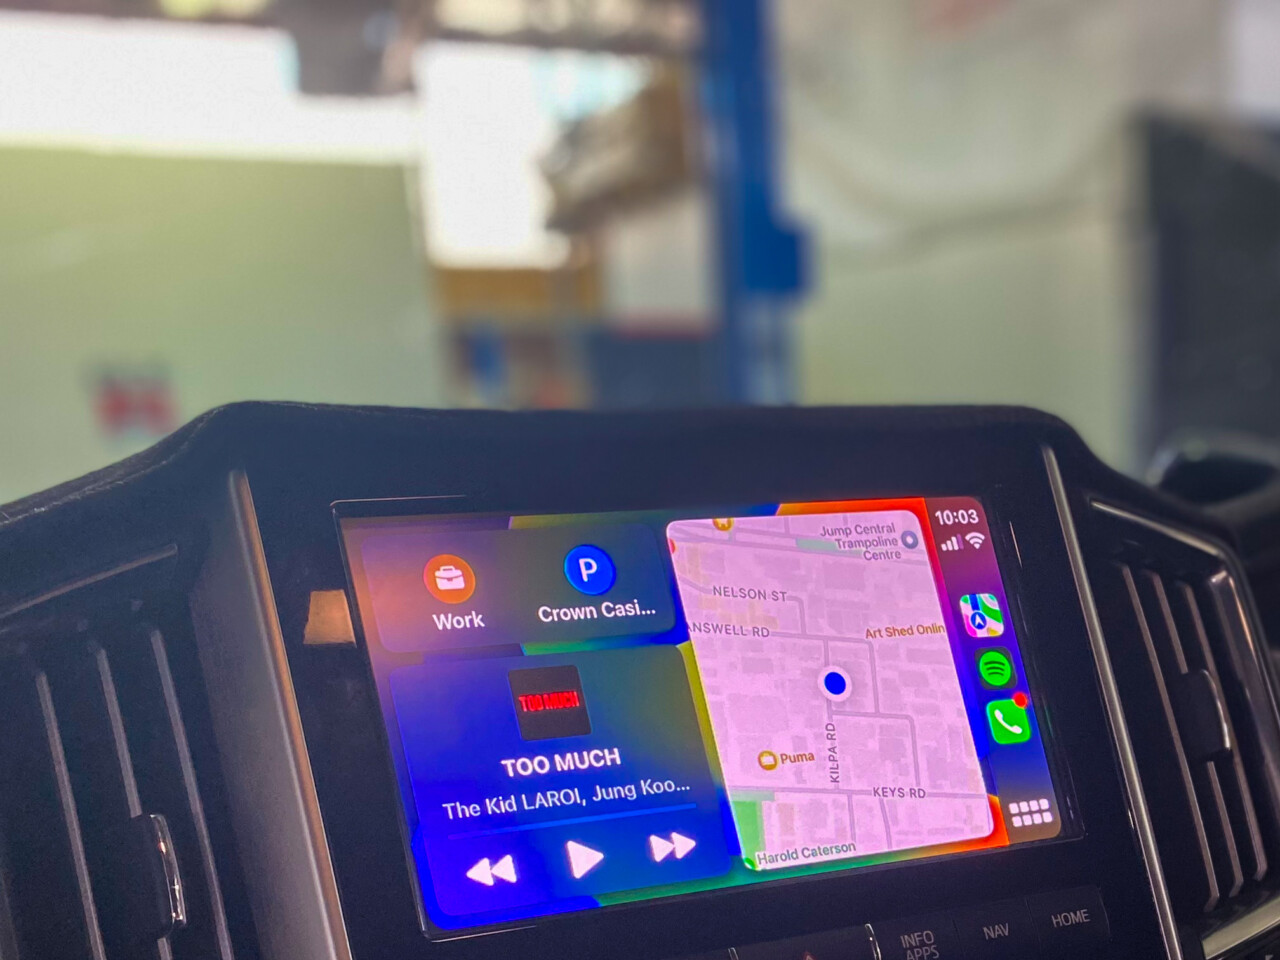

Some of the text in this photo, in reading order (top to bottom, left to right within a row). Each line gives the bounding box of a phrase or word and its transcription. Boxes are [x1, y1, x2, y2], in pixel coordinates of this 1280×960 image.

[935, 509, 979, 526] 10:03
[820, 522, 896, 538] Jump Central
[835, 536, 899, 550] Trampoline
[863, 549, 902, 561] Centre
[713, 585, 788, 602] NELSON ST
[432, 610, 485, 632] Work
[538, 603, 598, 623] Crown
[752, 626, 770, 638] RD
[865, 627, 883, 639] Art
[885, 625, 914, 637] Shed
[780, 752, 815, 764] Puma
[825, 722, 840, 784] KILPA RD
[501, 748, 621, 778] TOO MUCH
[442, 802, 481, 820] The
[485, 795, 518, 814] Kid
[523, 787, 587, 811] LAROI,
[592, 782, 637, 802] Jung
[873, 786, 926, 799] KEYS RD
[756, 839, 857, 867] Harold Caterson
[1051, 908, 1091, 928] HOME
[900, 930, 935, 949] INFO
[983, 923, 1010, 941] NAV
